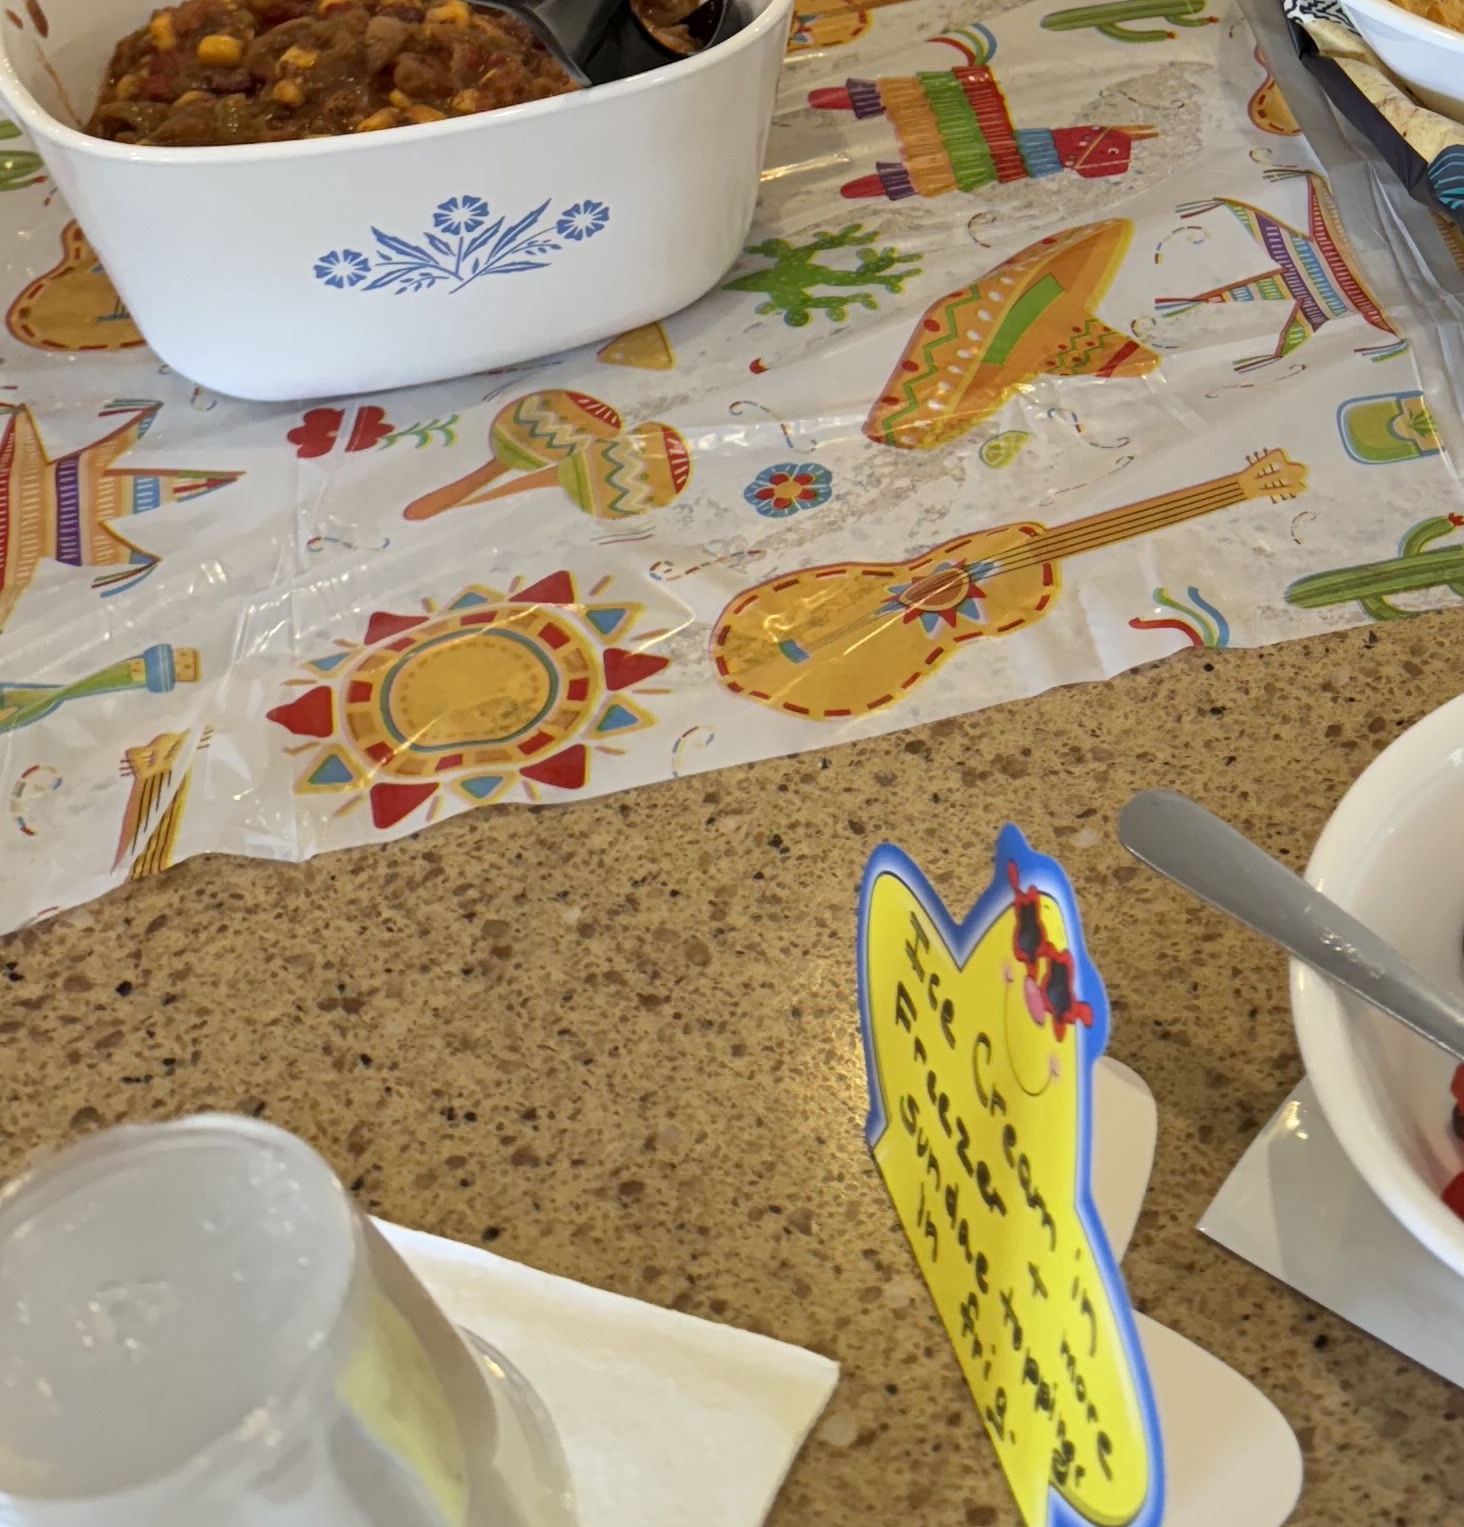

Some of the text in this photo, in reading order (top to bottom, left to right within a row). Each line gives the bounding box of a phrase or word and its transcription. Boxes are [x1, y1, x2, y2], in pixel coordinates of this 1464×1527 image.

[894, 980, 1008, 1219] Freezer
[1059, 1333, 1114, 1482] more
[903, 910, 1098, 1358] Ice Cream in
[999, 1286, 1090, 1490] toppings
